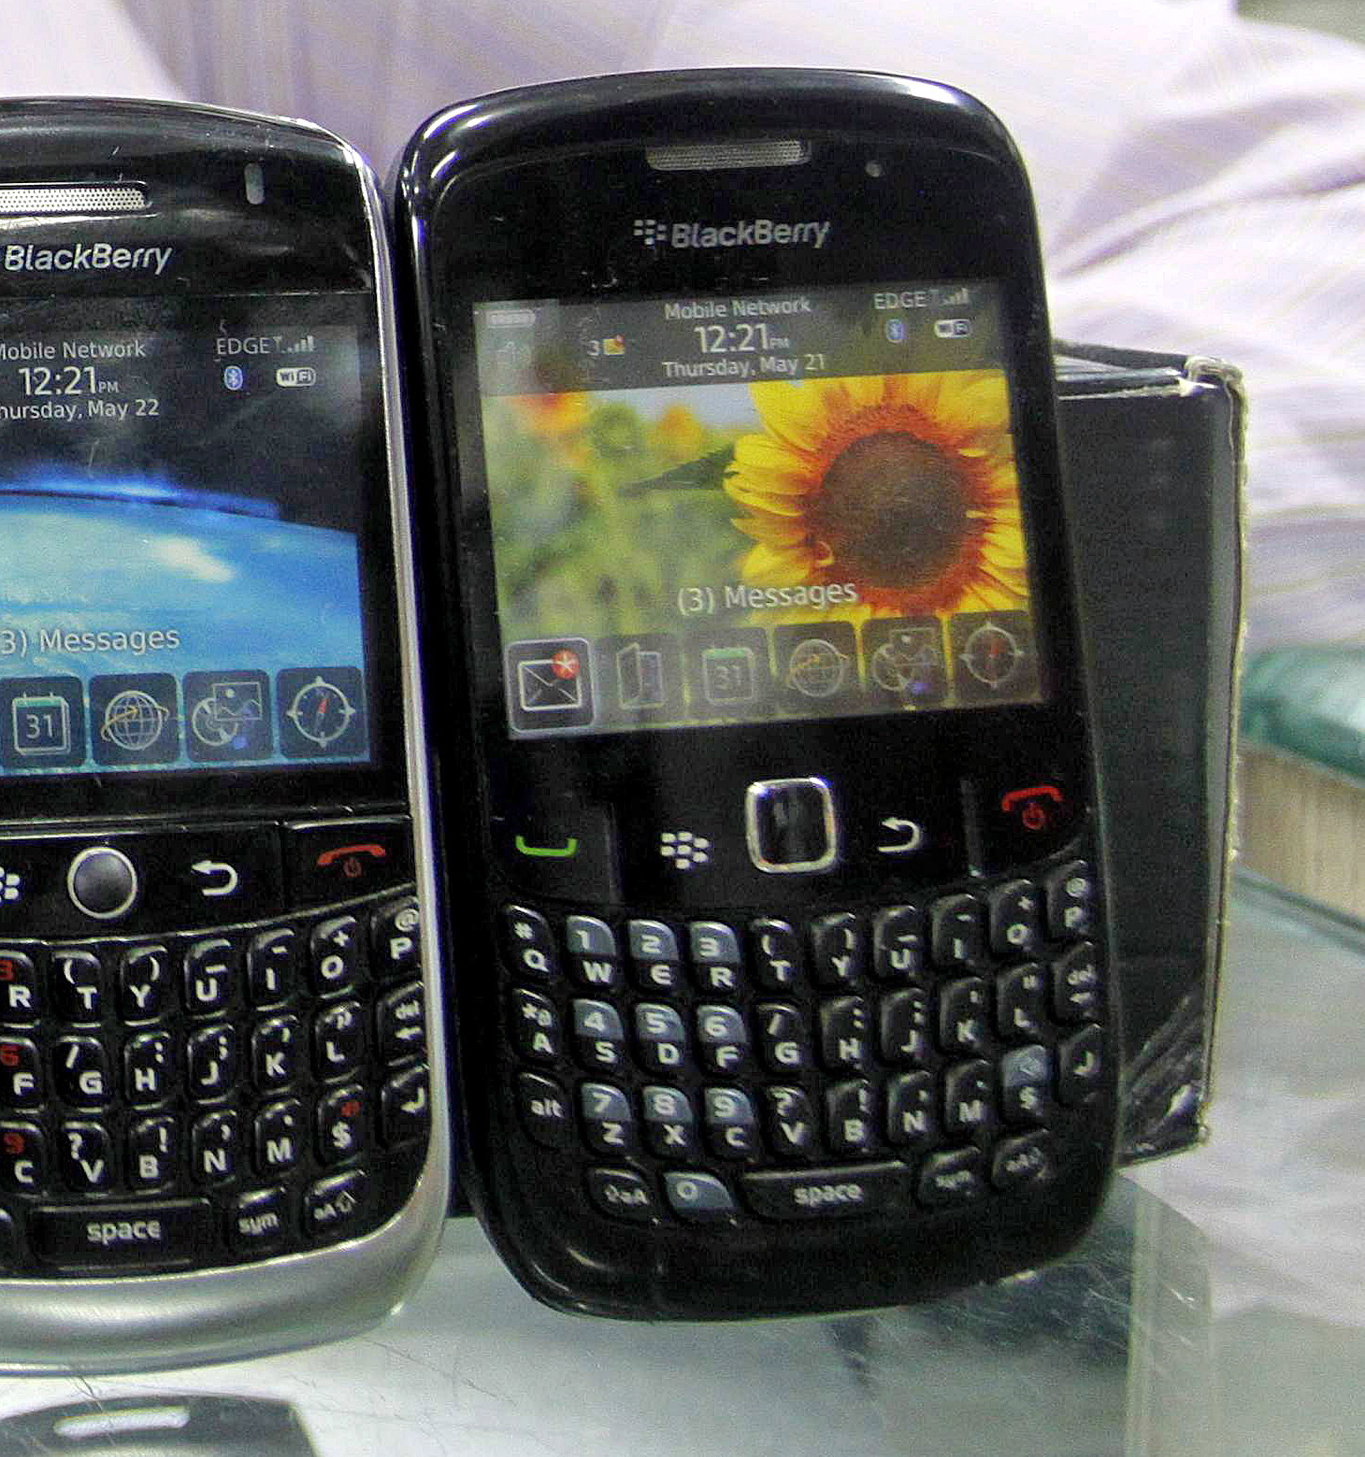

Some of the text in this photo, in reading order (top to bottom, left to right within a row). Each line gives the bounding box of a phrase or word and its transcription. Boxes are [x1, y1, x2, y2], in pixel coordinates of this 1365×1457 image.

[672, 220, 830, 248] BlackBerry
[5, 243, 172, 274] BlackBerry
[665, 296, 811, 321] Mobile Network
[874, 291, 927, 310] EDGE
[63, 339, 147, 358] Network
[217, 337, 272, 355] EDGE
[587, 340, 601, 356] 3
[88, 400, 128, 420] May
[136, 398, 159, 416] 22
[678, 582, 859, 615] (3) Messages
[39, 628, 180, 655] Messages
[26, 714, 52, 738] 31
[532, 1099, 562, 1117] alt
[87, 1221, 161, 1245] space
[239, 1213, 279, 1236] sym
